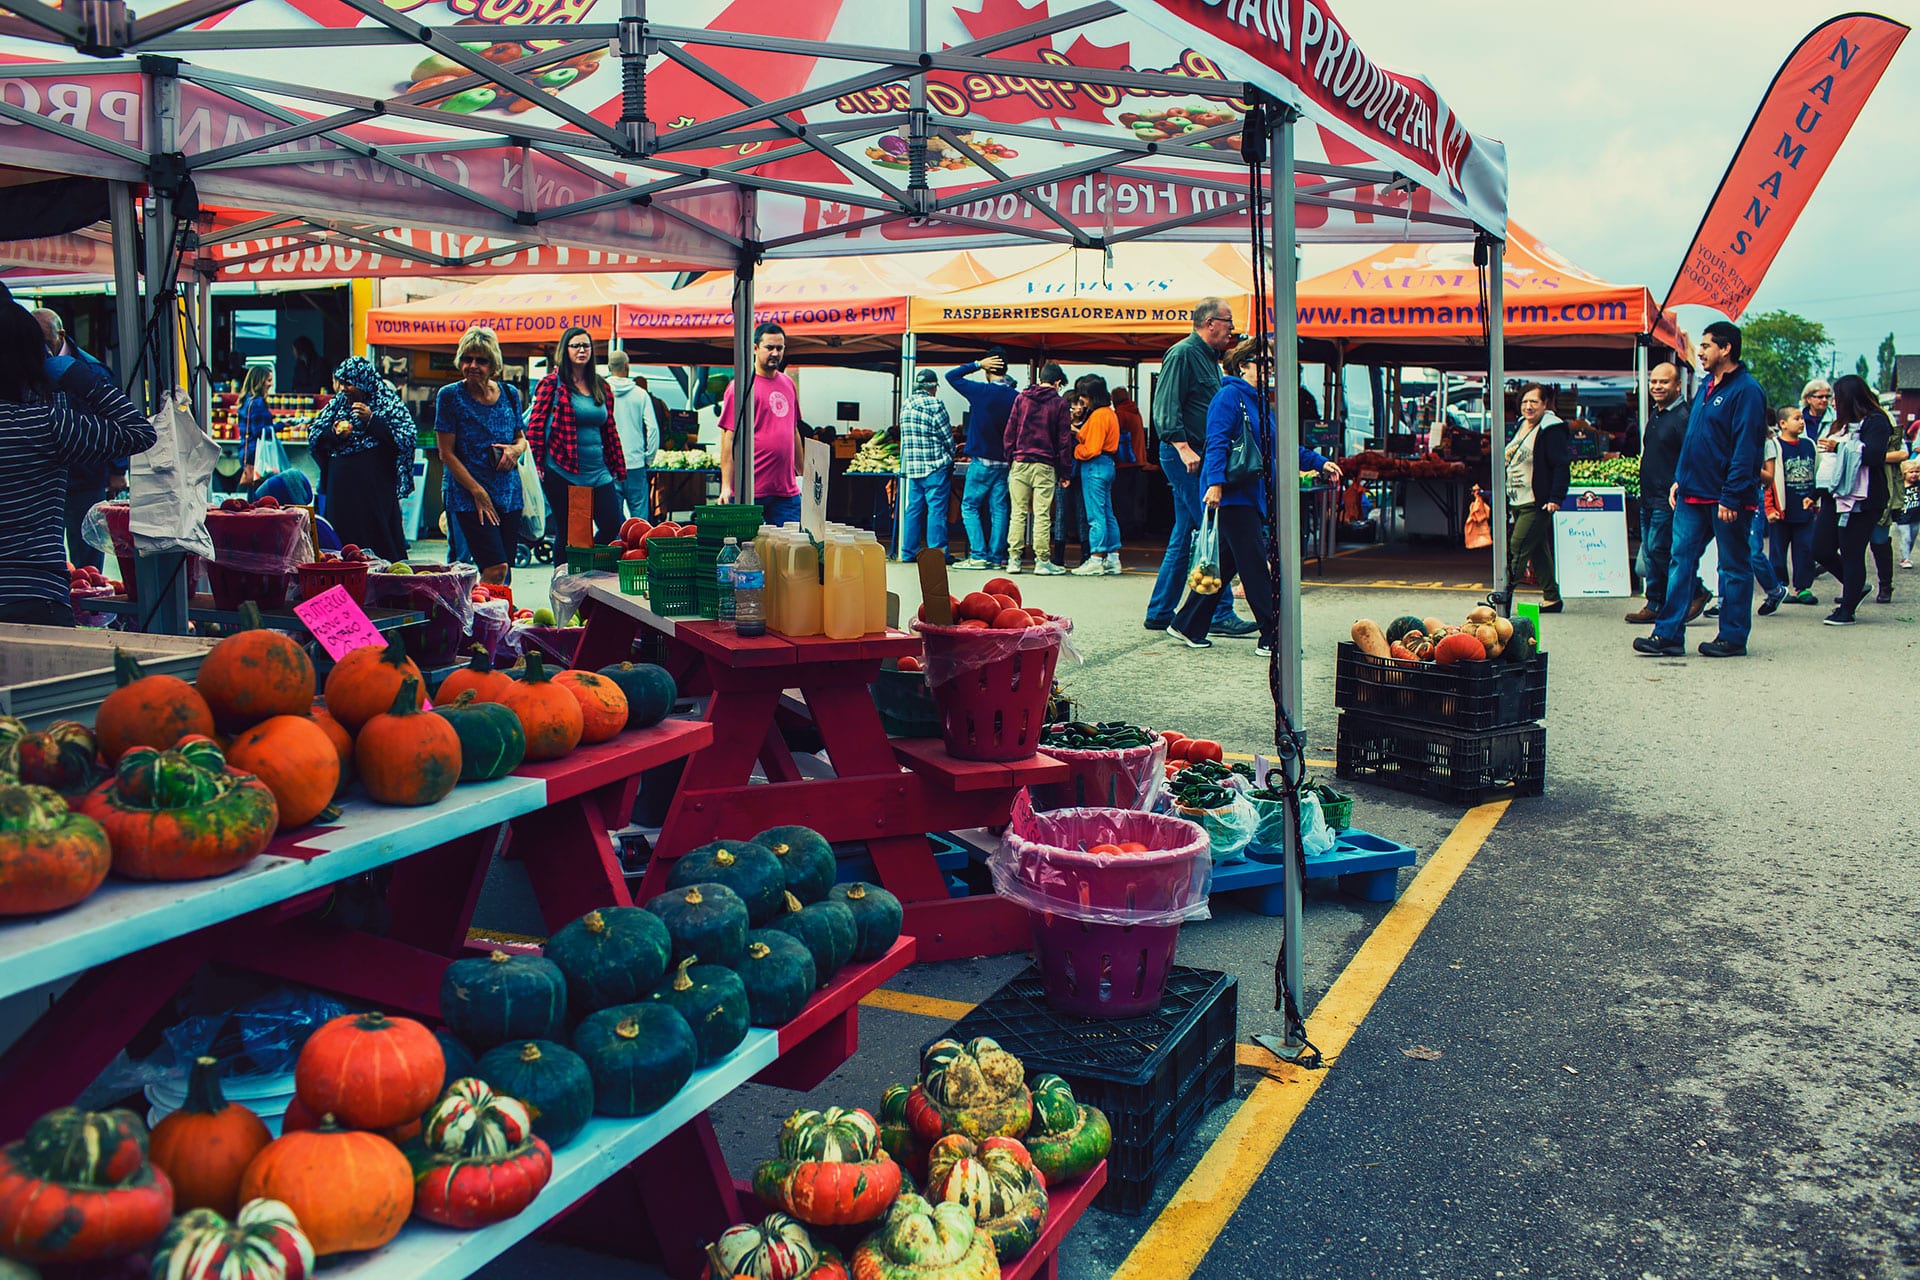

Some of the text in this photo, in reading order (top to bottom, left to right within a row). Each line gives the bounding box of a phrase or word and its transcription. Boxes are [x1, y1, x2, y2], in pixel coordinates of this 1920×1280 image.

[1300, 0, 1410, 137] PRODUCE
[1402, 93, 1434, 155] EH!
[1730, 35, 1861, 256] NAUMANS
[1344, 268, 1561, 290] NAUMN'S
[1684, 264, 1713, 292] FOOD
[1696, 258, 1711, 275] TO
[1698, 243, 1752, 296] YOUR PATH
[375, 320, 411, 334] YOUR
[413, 319, 446, 333] PATH
[449, 319, 466, 332] TO
[516, 316, 555, 331] FOOD
[559, 317, 569, 329] &
[573, 314, 602, 329] FUN
[629, 306, 896, 327] YOUR PATH TO REAT FOOD & FUN
[1267, 300, 1627, 325] ww.naumanfrm.com
